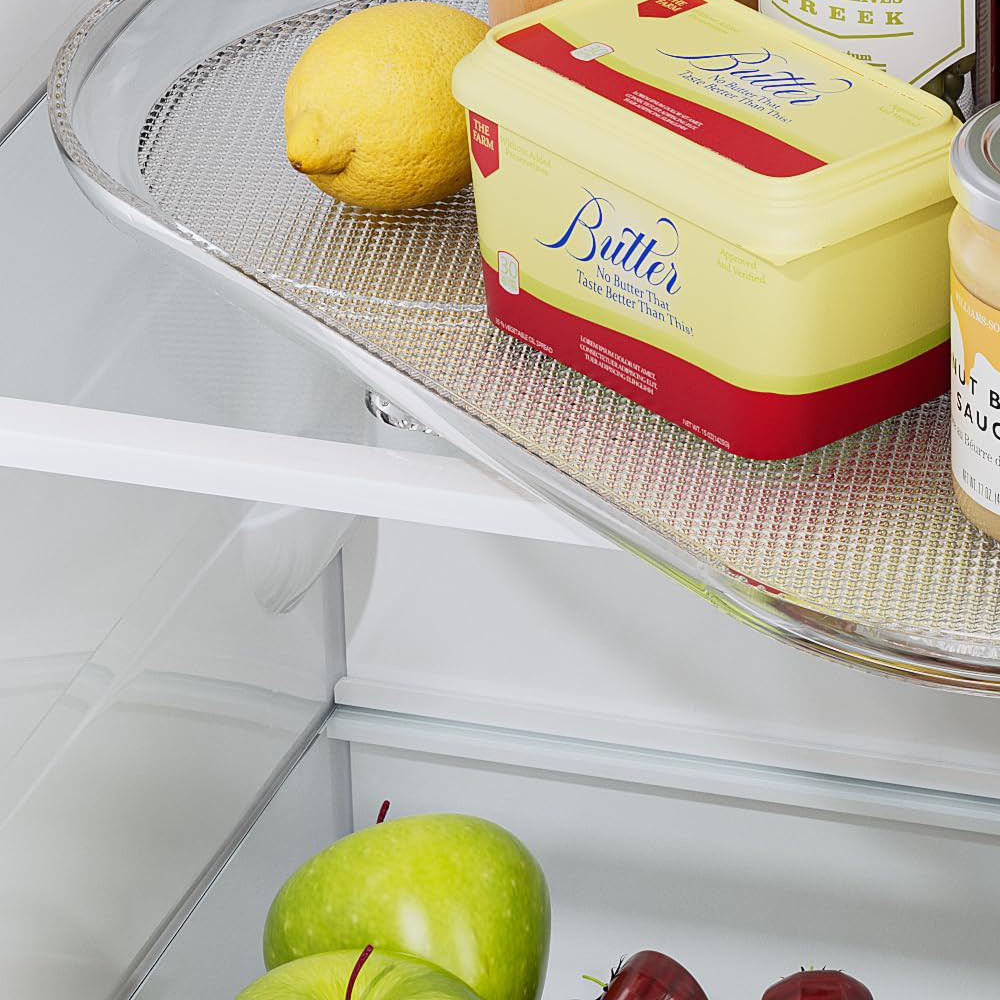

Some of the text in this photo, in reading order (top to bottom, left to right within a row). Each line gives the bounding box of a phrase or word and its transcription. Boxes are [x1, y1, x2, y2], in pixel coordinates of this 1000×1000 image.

[656, 46, 853, 106] Butter
[709, 74, 780, 110] No Butter That
[678, 70, 792, 124] Taste Better Than This!
[473, 118, 490, 136] THE
[473, 129, 494, 150] FARM
[535, 186, 682, 295] Butter
[500, 256, 517, 279] 30
[576, 268, 694, 336] Taste Better Than This!
[596, 264, 670, 312] No Butter That
[536, 340, 553, 354] SPREAD
[580, 336, 598, 350] LOREM
[598, 345, 614, 358] IPSUM
[614, 354, 632, 368] DOLOR
